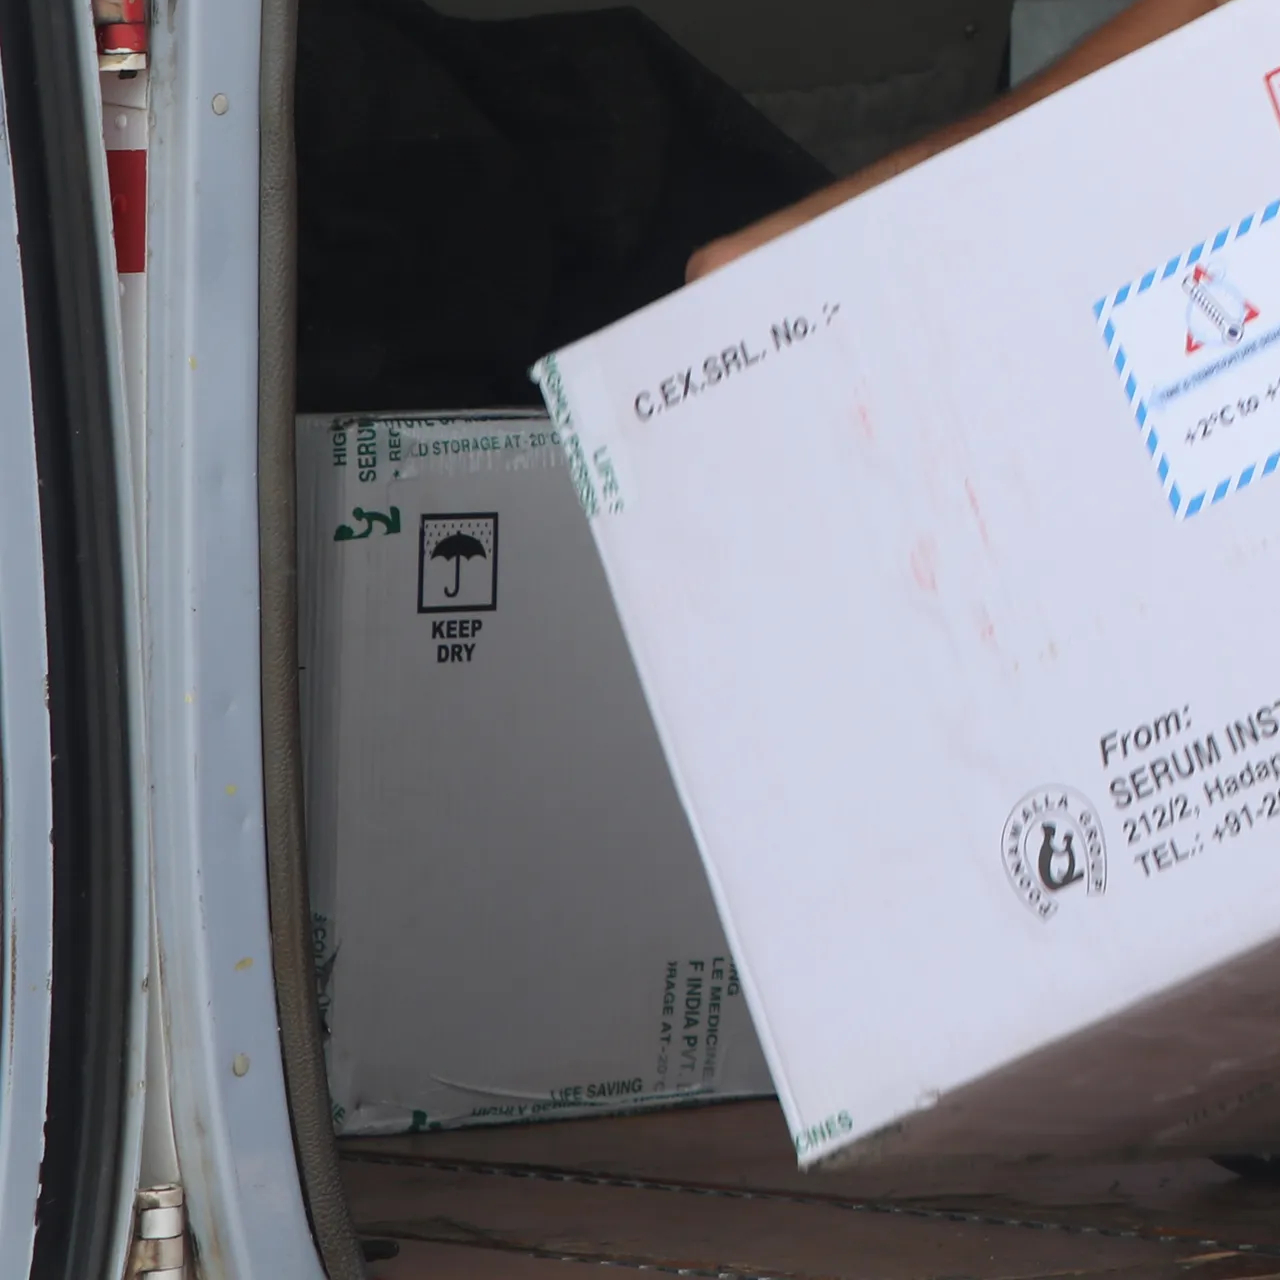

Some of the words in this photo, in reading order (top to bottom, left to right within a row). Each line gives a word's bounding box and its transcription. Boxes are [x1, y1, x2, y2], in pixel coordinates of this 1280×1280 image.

[1237, 394, 1260, 417] to
[432, 435, 501, 455] STORAGE
[431, 619, 483, 639] KEEP
[437, 642, 476, 664] DRY
[1100, 704, 1192, 768] From:
[1109, 733, 1222, 810] SERUM
[683, 977, 703, 1030] INDIA
[660, 1022, 673, 1046] AT
[701, 986, 722, 1087] MEDICINE
[586, 1077, 643, 1099] SAVING
